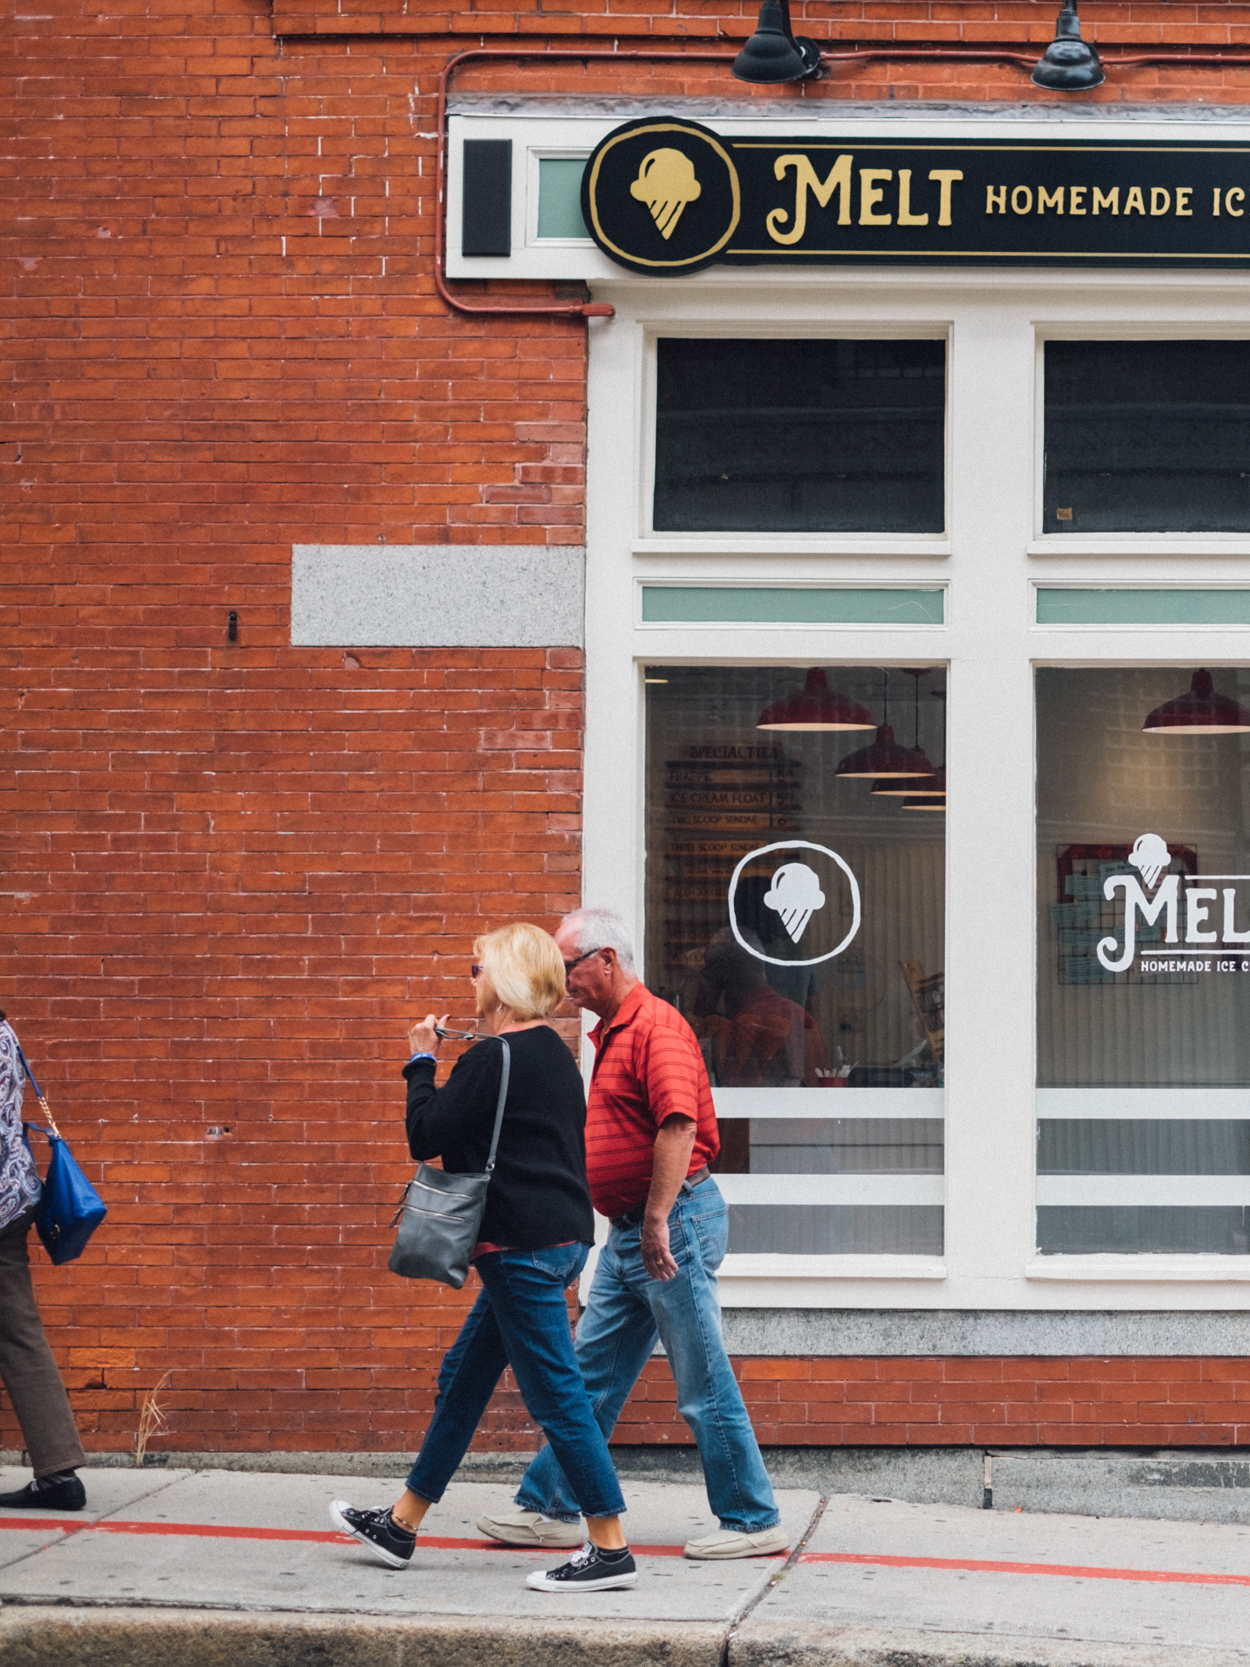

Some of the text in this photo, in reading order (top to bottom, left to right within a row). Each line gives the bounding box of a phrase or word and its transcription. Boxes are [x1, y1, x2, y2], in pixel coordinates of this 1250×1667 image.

[765, 153, 965, 246] MELT
[985, 184, 1195, 218] HOMEMADE
[690, 793, 729, 804] CREAM
[732, 793, 766, 804] FLOAT
[693, 816, 723, 824] SCOOP
[1140, 960, 1212, 973] HOMEMADE
[1216, 960, 1237, 973] ICE
